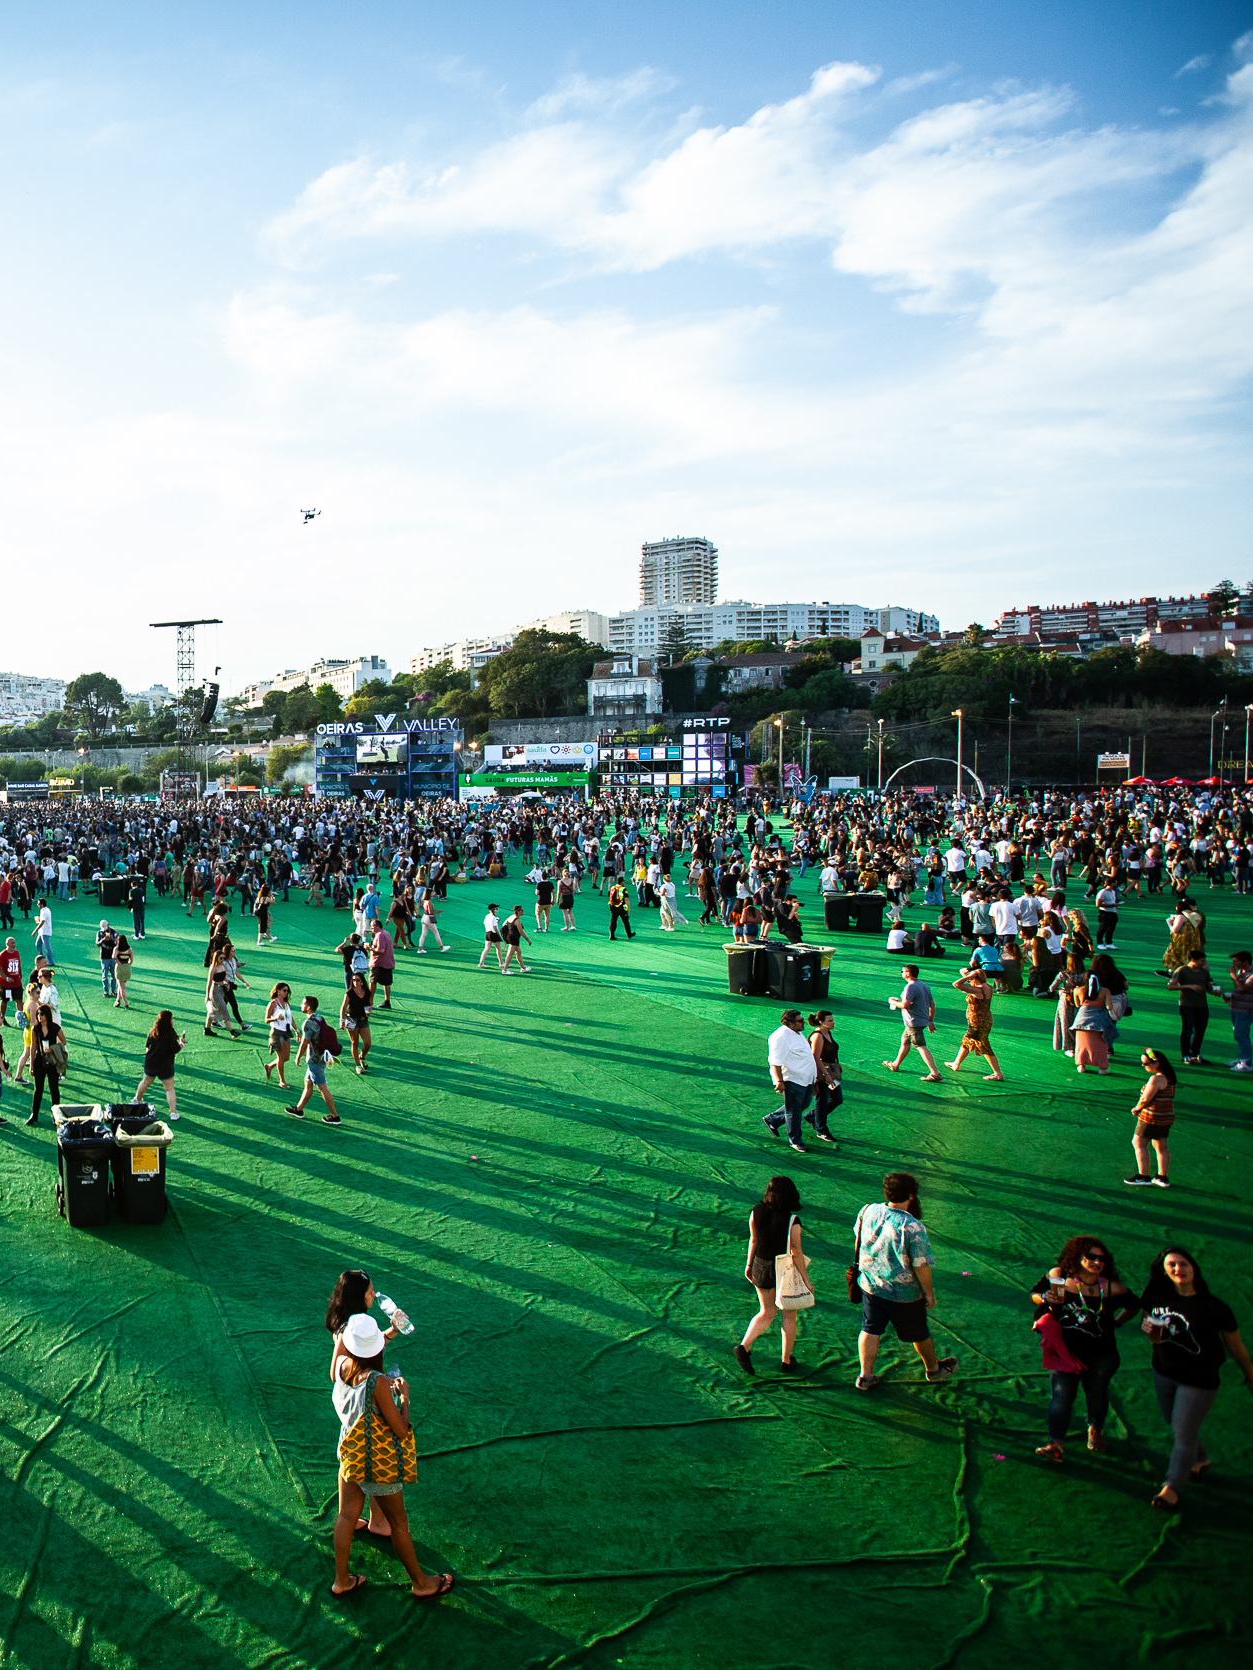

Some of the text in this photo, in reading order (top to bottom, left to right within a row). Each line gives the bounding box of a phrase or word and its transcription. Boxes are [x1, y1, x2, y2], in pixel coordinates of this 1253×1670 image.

[316, 717, 457, 735] OEIRAS VALLEY
[682, 717, 731, 728] #RTP
